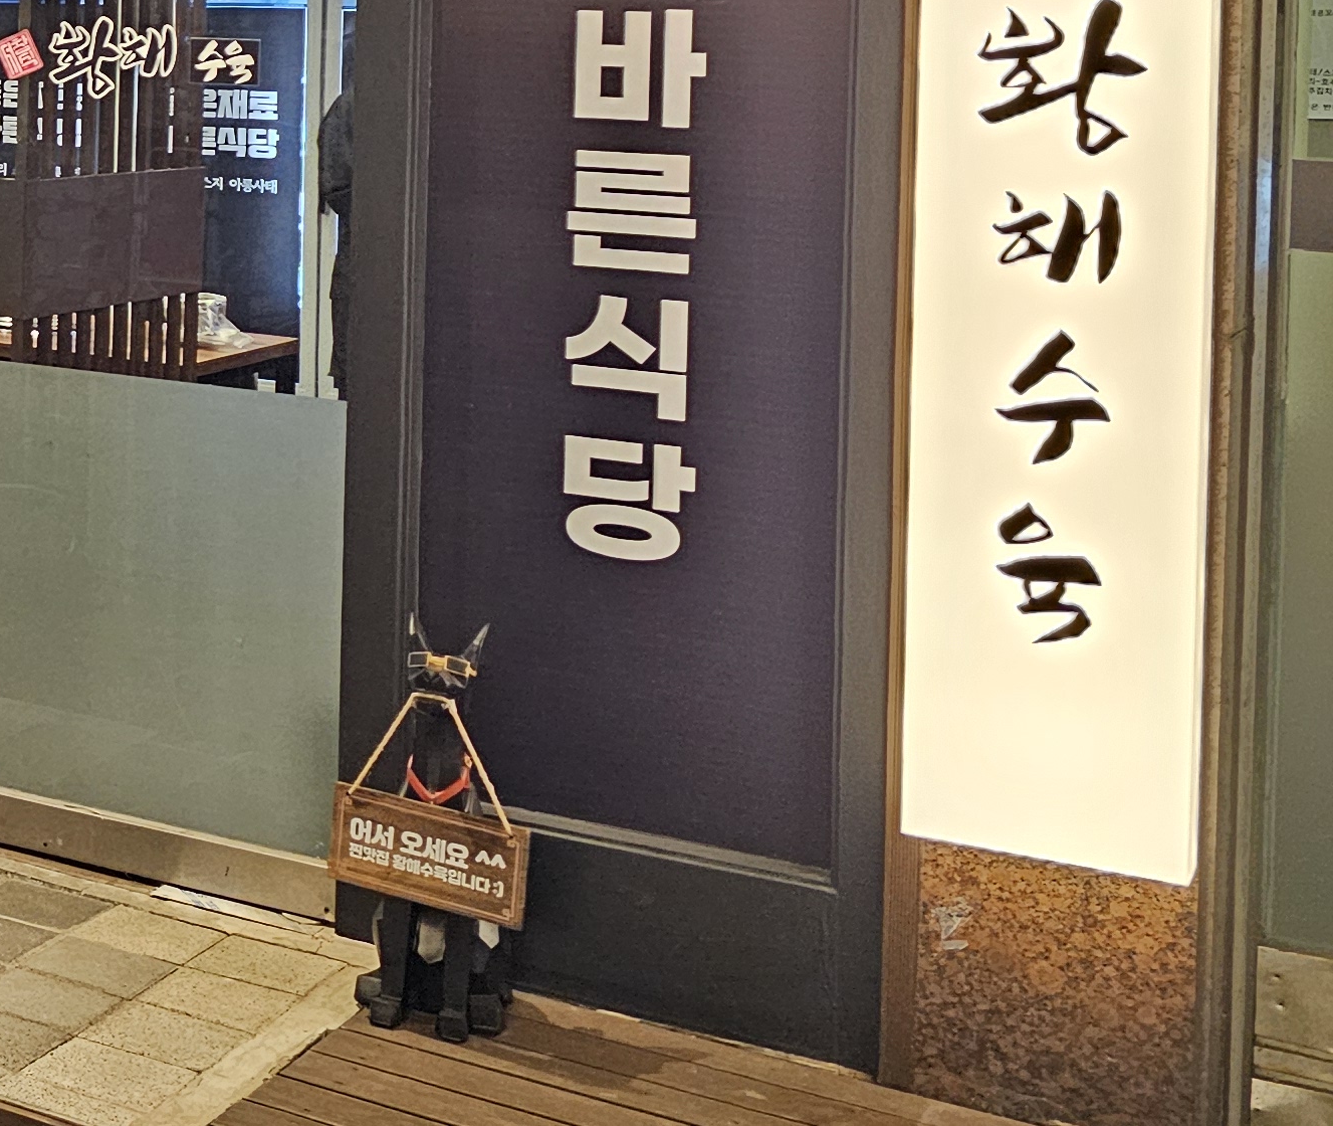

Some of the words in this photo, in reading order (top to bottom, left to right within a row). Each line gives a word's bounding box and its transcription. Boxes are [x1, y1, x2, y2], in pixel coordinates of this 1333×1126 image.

[194, 39, 255, 85] 수육
[563, 8, 708, 562] 바른식당
[348, 842, 391, 867] 찐맛집
[349, 817, 395, 850] 어서
[400, 830, 470, 870] 오세요
